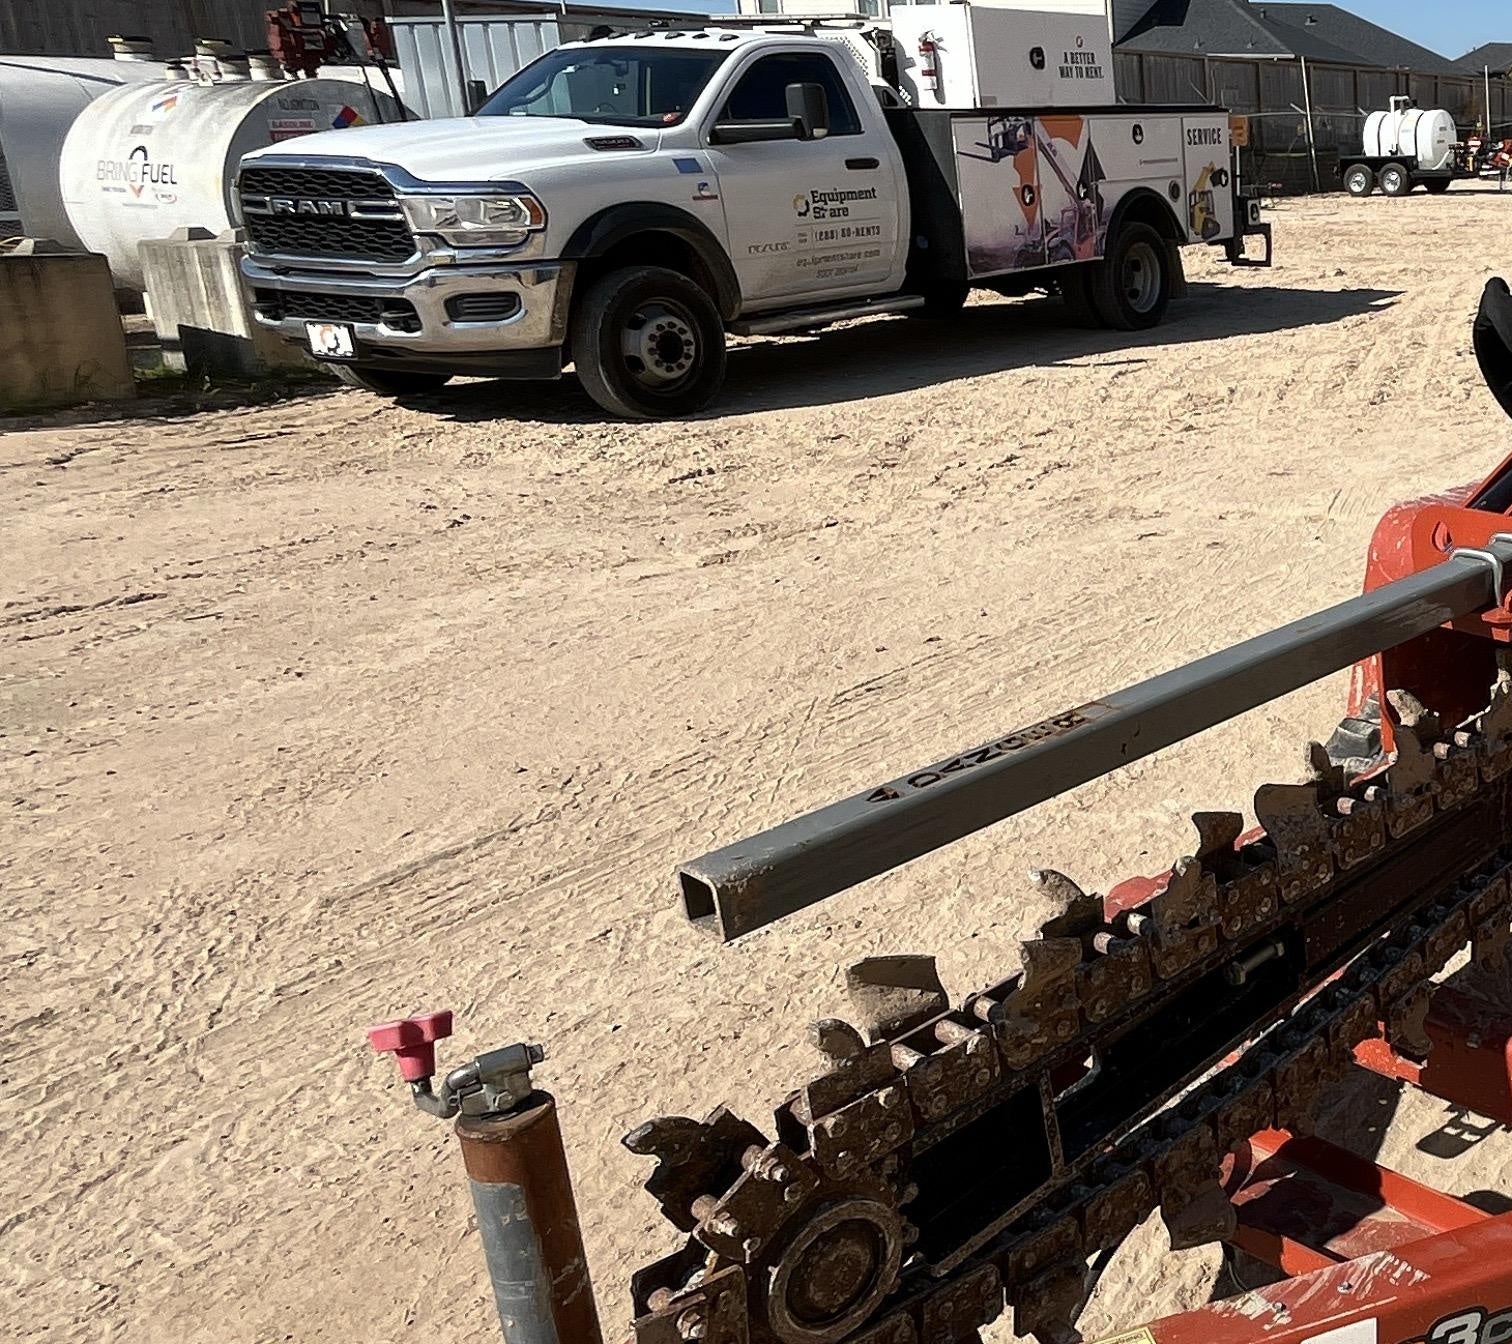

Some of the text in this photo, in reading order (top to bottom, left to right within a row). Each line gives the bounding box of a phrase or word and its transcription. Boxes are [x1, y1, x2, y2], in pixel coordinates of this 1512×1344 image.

[1071, 52, 1095, 65] BETTER
[1059, 66, 1075, 79] WAY
[1076, 66, 1084, 79] TO
[1187, 127, 1222, 146] SERVICE
[97, 160, 178, 185] BRING FUEL
[810, 187, 877, 205] Equipment
[272, 199, 345, 216] RAM
[907, 710, 1086, 788] DANGER
